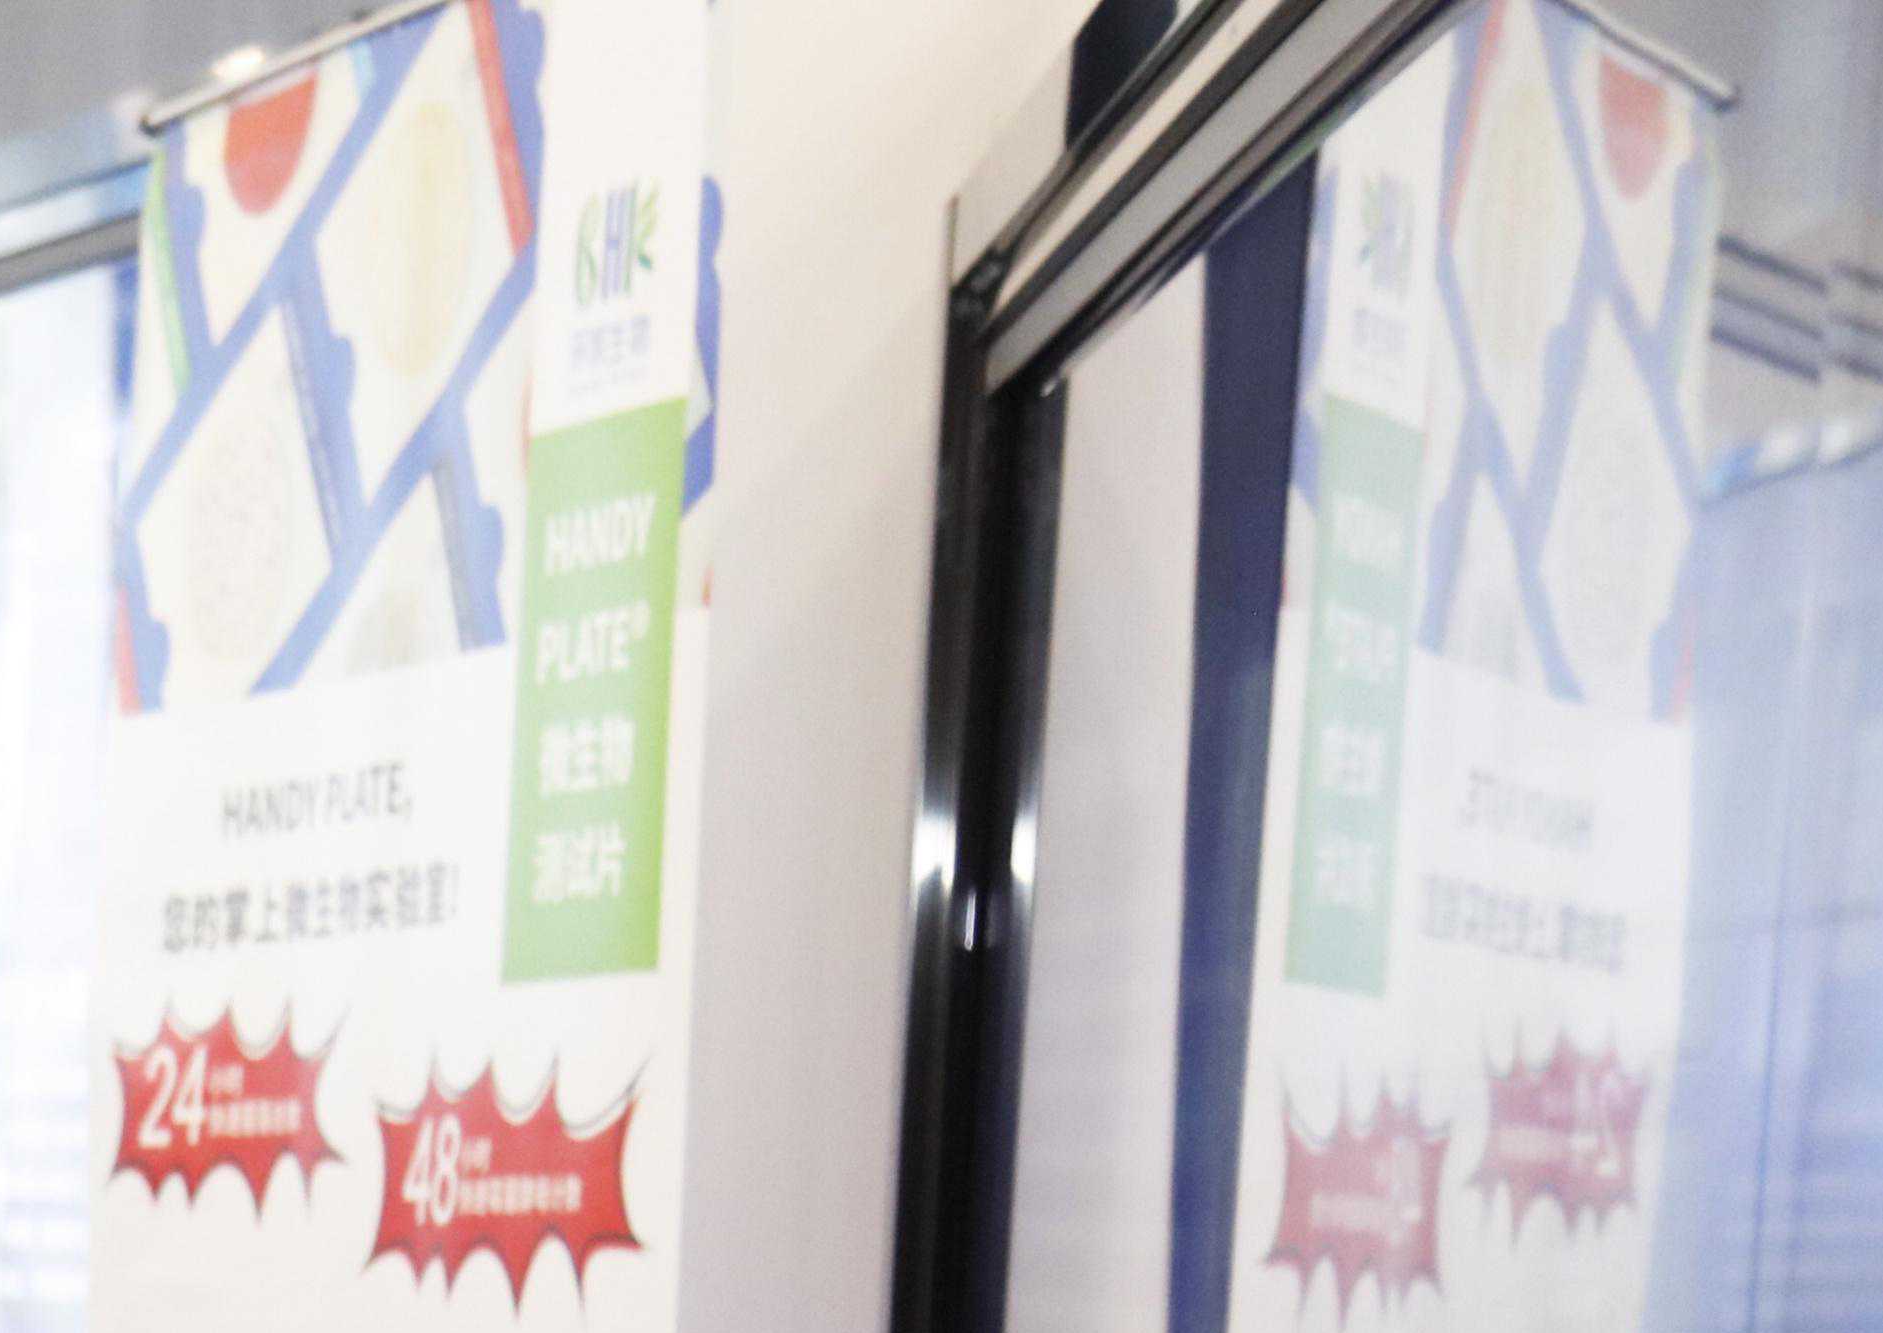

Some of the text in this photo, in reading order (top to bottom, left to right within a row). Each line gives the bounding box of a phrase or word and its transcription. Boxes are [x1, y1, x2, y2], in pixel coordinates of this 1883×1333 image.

[543, 492, 656, 575] HANDY
[138, 1042, 208, 1149] 24
[402, 1113, 462, 1226] 48
